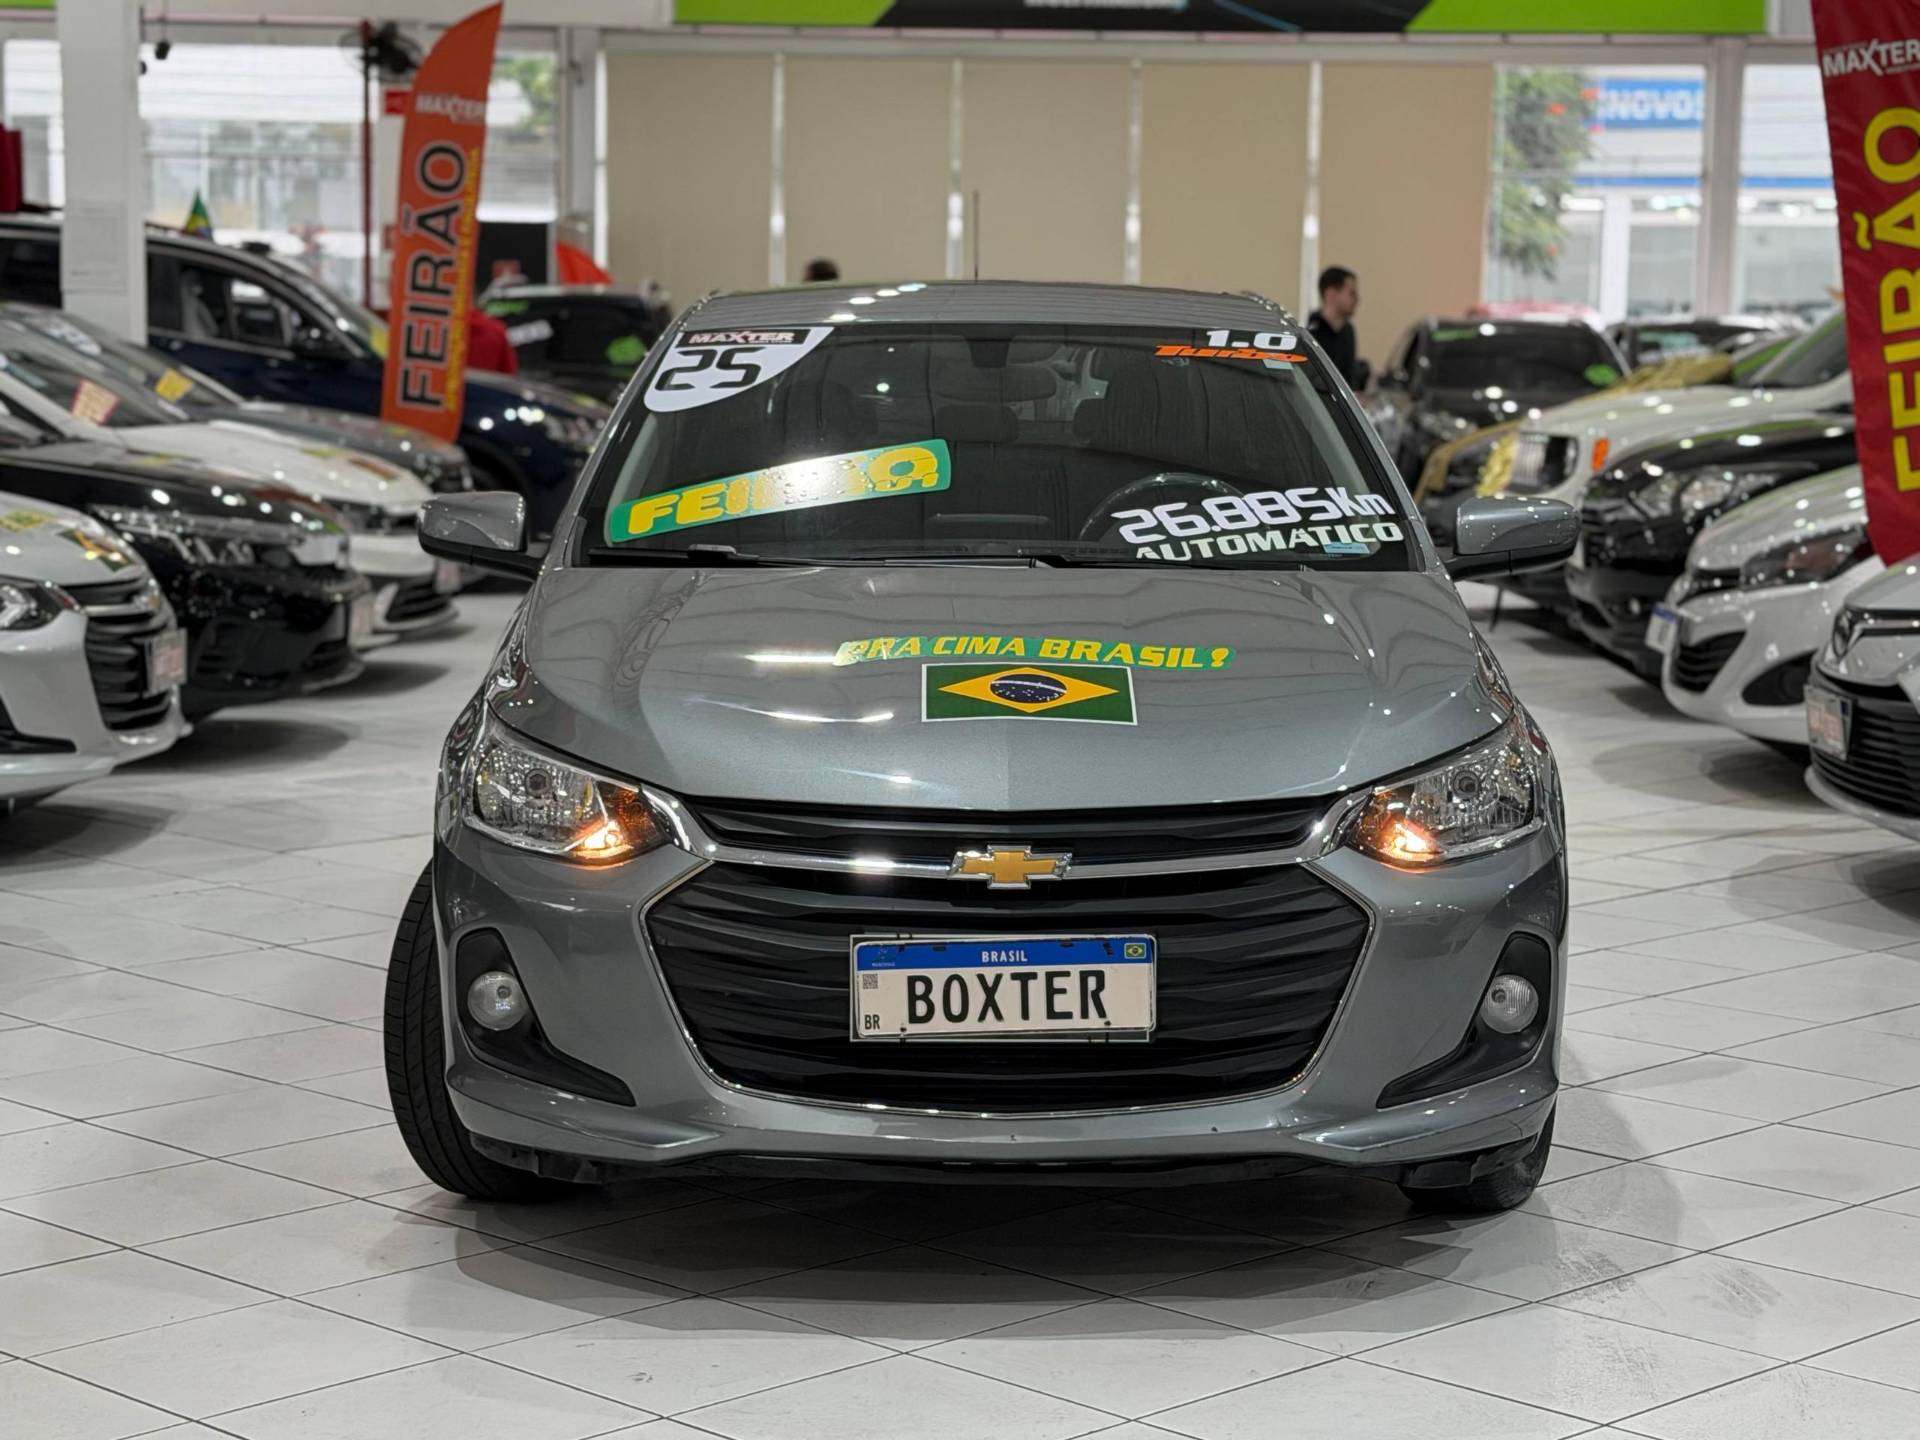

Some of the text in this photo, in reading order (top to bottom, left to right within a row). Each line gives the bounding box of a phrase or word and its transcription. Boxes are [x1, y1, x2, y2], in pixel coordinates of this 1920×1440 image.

[1822, 38, 1920, 77] MAXTER
[399, 142, 467, 409] FEIRÃO
[688, 330, 795, 345] MAXTER
[1206, 329, 1297, 350] 1.0
[654, 346, 767, 391] 25
[628, 446, 939, 535] FEIO
[845, 636, 921, 660] PRA
[931, 635, 1026, 657] CIMA
[981, 950, 1028, 963] BRASIL
[907, 969, 1107, 1024] BOXTER
[864, 1014, 880, 1030] BR
